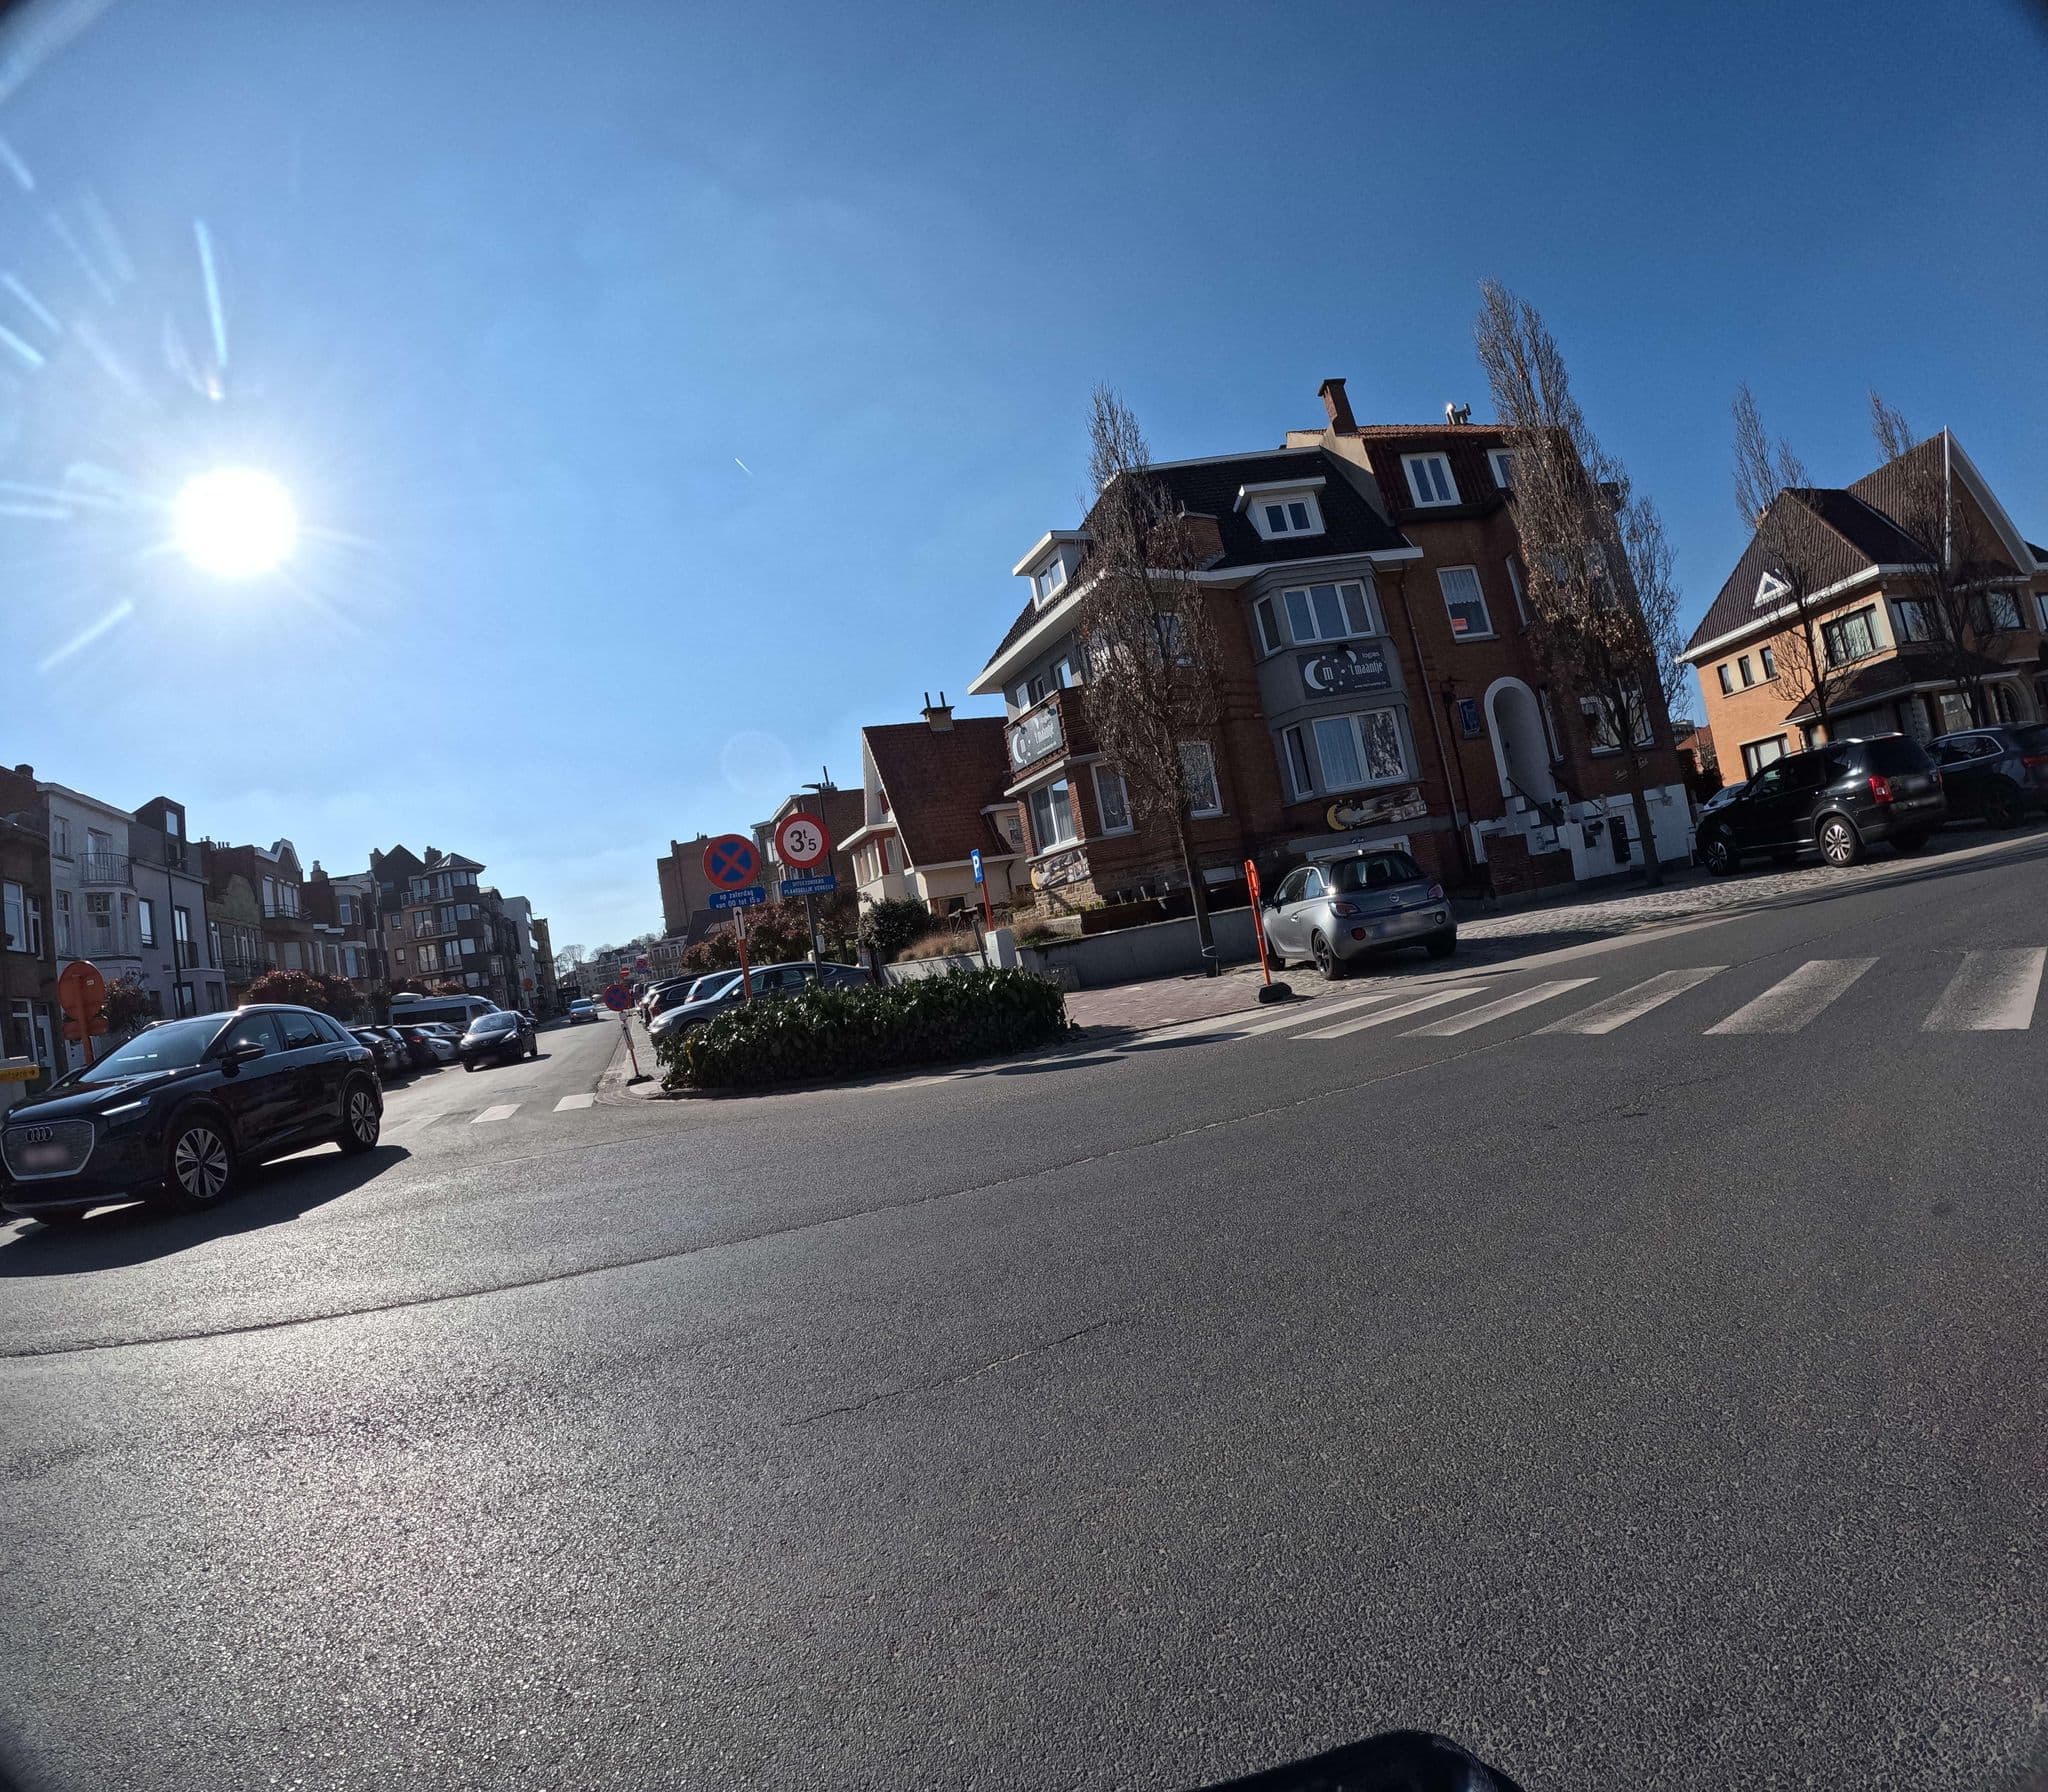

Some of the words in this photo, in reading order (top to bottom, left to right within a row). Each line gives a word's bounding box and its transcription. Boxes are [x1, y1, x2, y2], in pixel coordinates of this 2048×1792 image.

[1355, 661, 1383, 675] maantje
[972, 855, 980, 878] P
[729, 890, 754, 899] zaterdag
